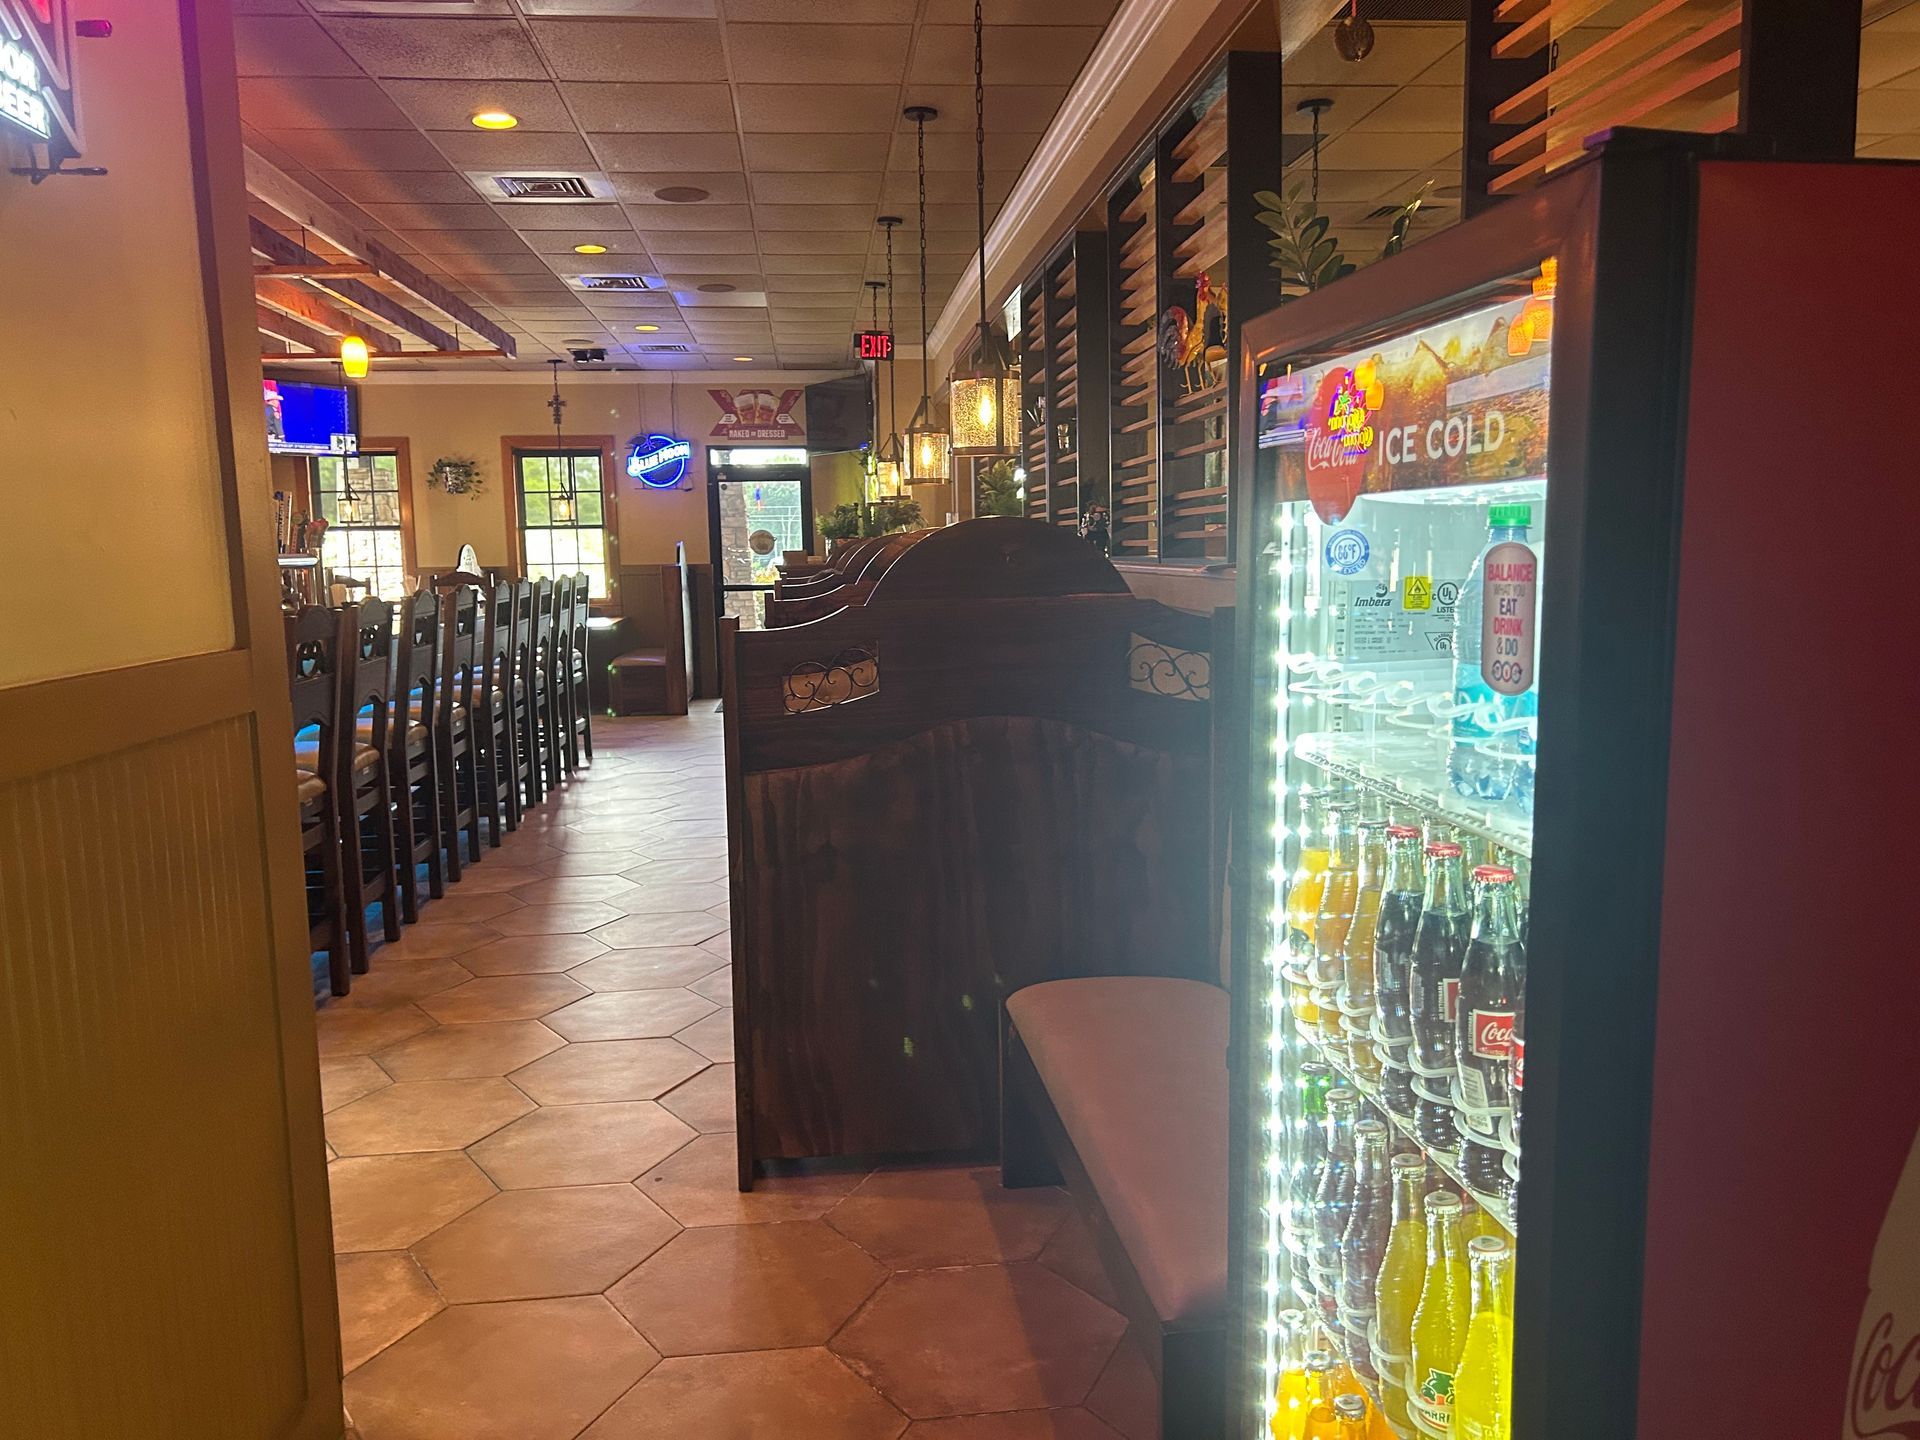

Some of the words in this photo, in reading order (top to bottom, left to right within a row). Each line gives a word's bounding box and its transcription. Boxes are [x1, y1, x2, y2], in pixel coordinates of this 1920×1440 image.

[861, 335, 888, 358] EXIT
[729, 429, 750, 438] NAKED
[757, 429, 786, 438] DRESSED
[1378, 424, 1418, 466] ICE
[1425, 410, 1505, 459] COLD
[627, 454, 659, 477] BLUE
[659, 445, 689, 463] MOON
[1487, 563, 1533, 582] BALANCE
[1494, 583, 1511, 596] WHAT
[1513, 583, 1526, 597] YOU
[1354, 596, 1393, 607] Imbera
[1500, 598, 1517, 615] EAT
[1493, 617, 1523, 636] DRINK
[1496, 637, 1503, 654] &
[1505, 638, 1518, 656] DO
[1418, 1408, 1450, 1423] ARRI
